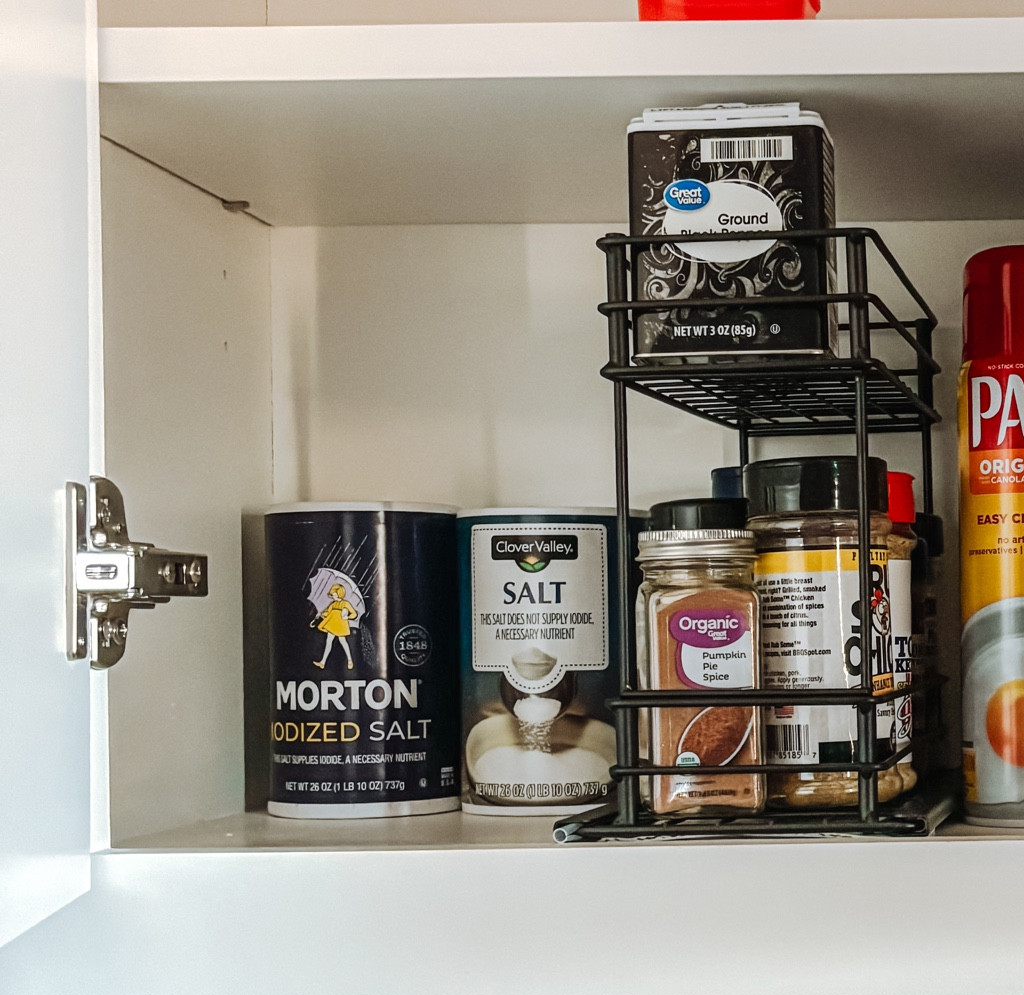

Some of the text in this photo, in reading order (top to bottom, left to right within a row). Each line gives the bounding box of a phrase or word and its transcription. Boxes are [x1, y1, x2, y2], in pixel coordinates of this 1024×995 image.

[670, 187, 702, 198] Great
[678, 197, 702, 205] Value
[718, 212, 769, 225] Ground
[674, 324, 756, 337] NET WT 3 OZ (85g)
[978, 514, 1007, 525] EASY
[496, 540, 572, 555] Clover Valley
[503, 582, 567, 605] SALT
[803, 585, 826, 593] smoked
[806, 603, 824, 611] spices
[480, 614, 492, 625] THIS
[492, 613, 507, 626] SALT
[508, 613, 525, 625] DOES
[526, 613, 540, 625] NOT
[542, 613, 569, 625] SUPPLY
[679, 615, 739, 634] Organic
[799, 620, 817, 628] things
[496, 628, 575, 640] A NECESSARY NUTRIENT
[399, 640, 428, 651] 1848
[703, 651, 747, 661] Pumpkin
[703, 662, 718, 670] Pie
[703, 673, 730, 683] Spice
[276, 679, 418, 711] MORTON
[370, 719, 432, 741] SALT
[292, 755, 319, 765] SUPPLIES
[345, 754, 351, 764] A
[352, 753, 394, 764] NECESSARY
[395, 752, 427, 762] NUTRIENT
[285, 780, 405, 793] NET WT 26 OZ (1 LB 10 OZ) 737g
[476, 783, 487, 796] NET
[487, 784, 500, 796] WT
[500, 784, 511, 797] 26
[512, 784, 526, 797] OZ
[537, 784, 550, 797] LB
[551, 784, 563, 797] 10
[584, 782, 600, 796] 737
[601, 784, 608, 796] g
